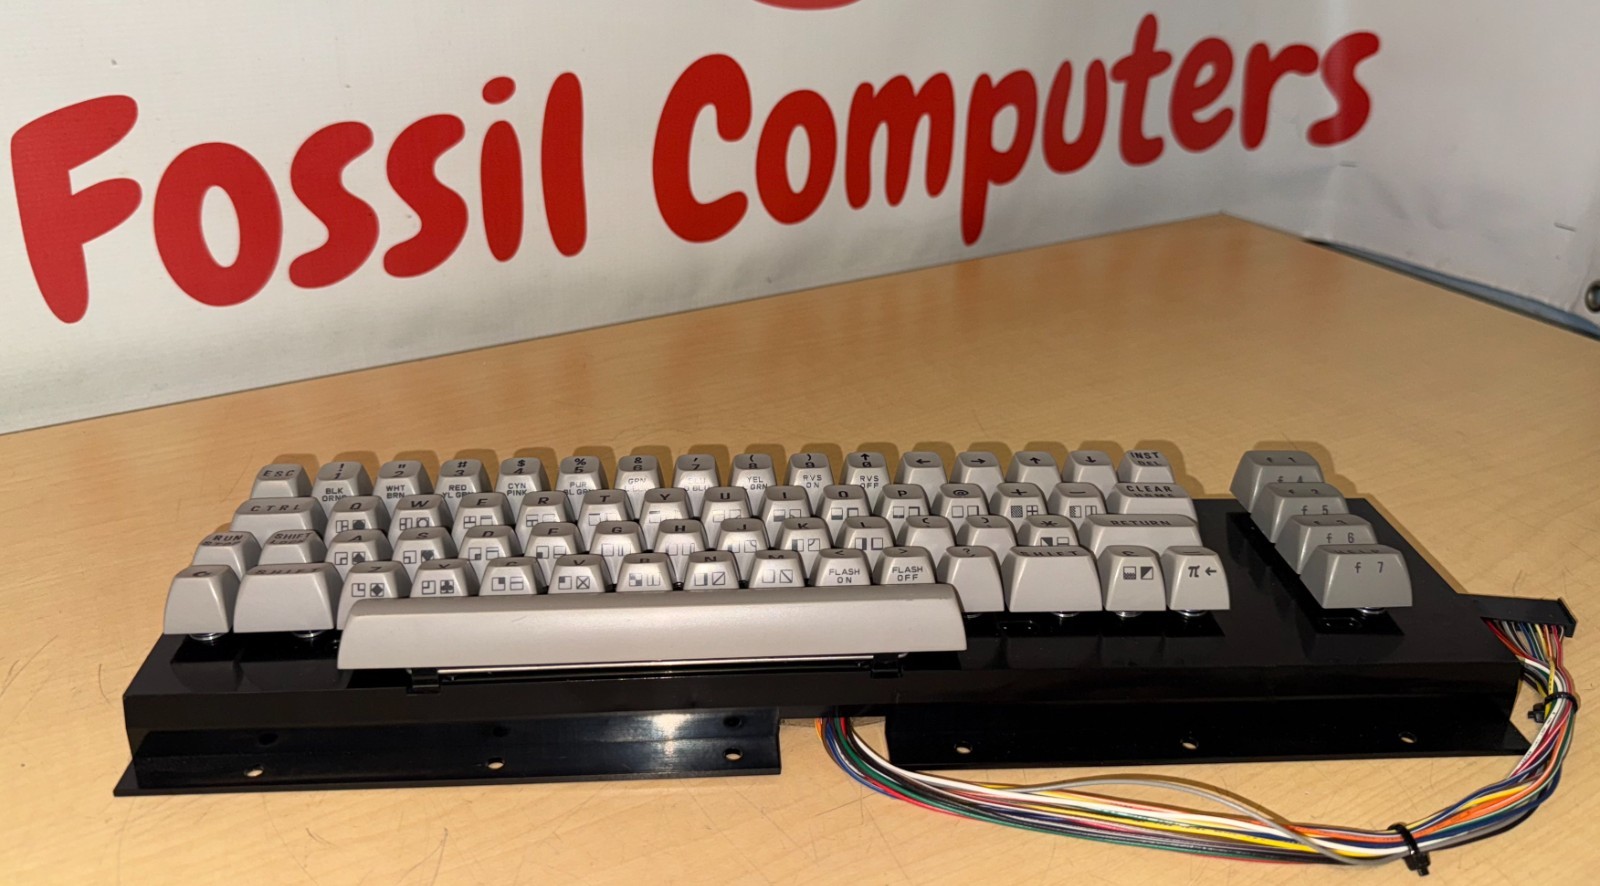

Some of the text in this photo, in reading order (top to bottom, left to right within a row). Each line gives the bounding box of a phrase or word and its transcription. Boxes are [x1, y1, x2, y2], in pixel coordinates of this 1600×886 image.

[10, 14, 1381, 324] Fossil Computers
[1130, 451, 1160, 460] INST
[574, 457, 587, 466] %
[513, 467, 525, 475] 4
[573, 466, 585, 474] 5
[691, 463, 701, 471] 7
[262, 469, 296, 478] ESC
[391, 470, 405, 478] 2
[453, 469, 465, 477] 3
[746, 476, 764, 484] YEL
[802, 474, 823, 482] RVS
[859, 475, 880, 483] RVS
[385, 484, 406, 492] WHT
[448, 484, 467, 492] RED
[507, 482, 527, 490] CYN
[569, 481, 588, 489] PUR
[1125, 485, 1173, 493] CLEAR
[325, 487, 344, 495] BLK
[386, 491, 405, 499] BRN
[506, 489, 528, 497] PINK
[896, 489, 908, 497] P
[952, 489, 969, 497] @
[599, 495, 611, 503] T
[659, 493, 671, 501] Y
[719, 492, 731, 500] U
[410, 500, 429, 508] W
[537, 496, 550, 505] R
[249, 503, 302, 512] CTRL
[736, 523, 747, 531] J
[797, 522, 810, 530] K
[1109, 519, 1172, 527] RETURN
[611, 526, 623, 534] G
[674, 524, 686, 532] H
[274, 532, 313, 540] SHIFT
[348, 534, 363, 542] A
[482, 530, 495, 538] D
[891, 566, 924, 574] FLASH
[1376, 561, 1384, 574] 7
[828, 568, 861, 577] FLASH
[836, 576, 853, 584] ON
[896, 573, 919, 582] OFF
